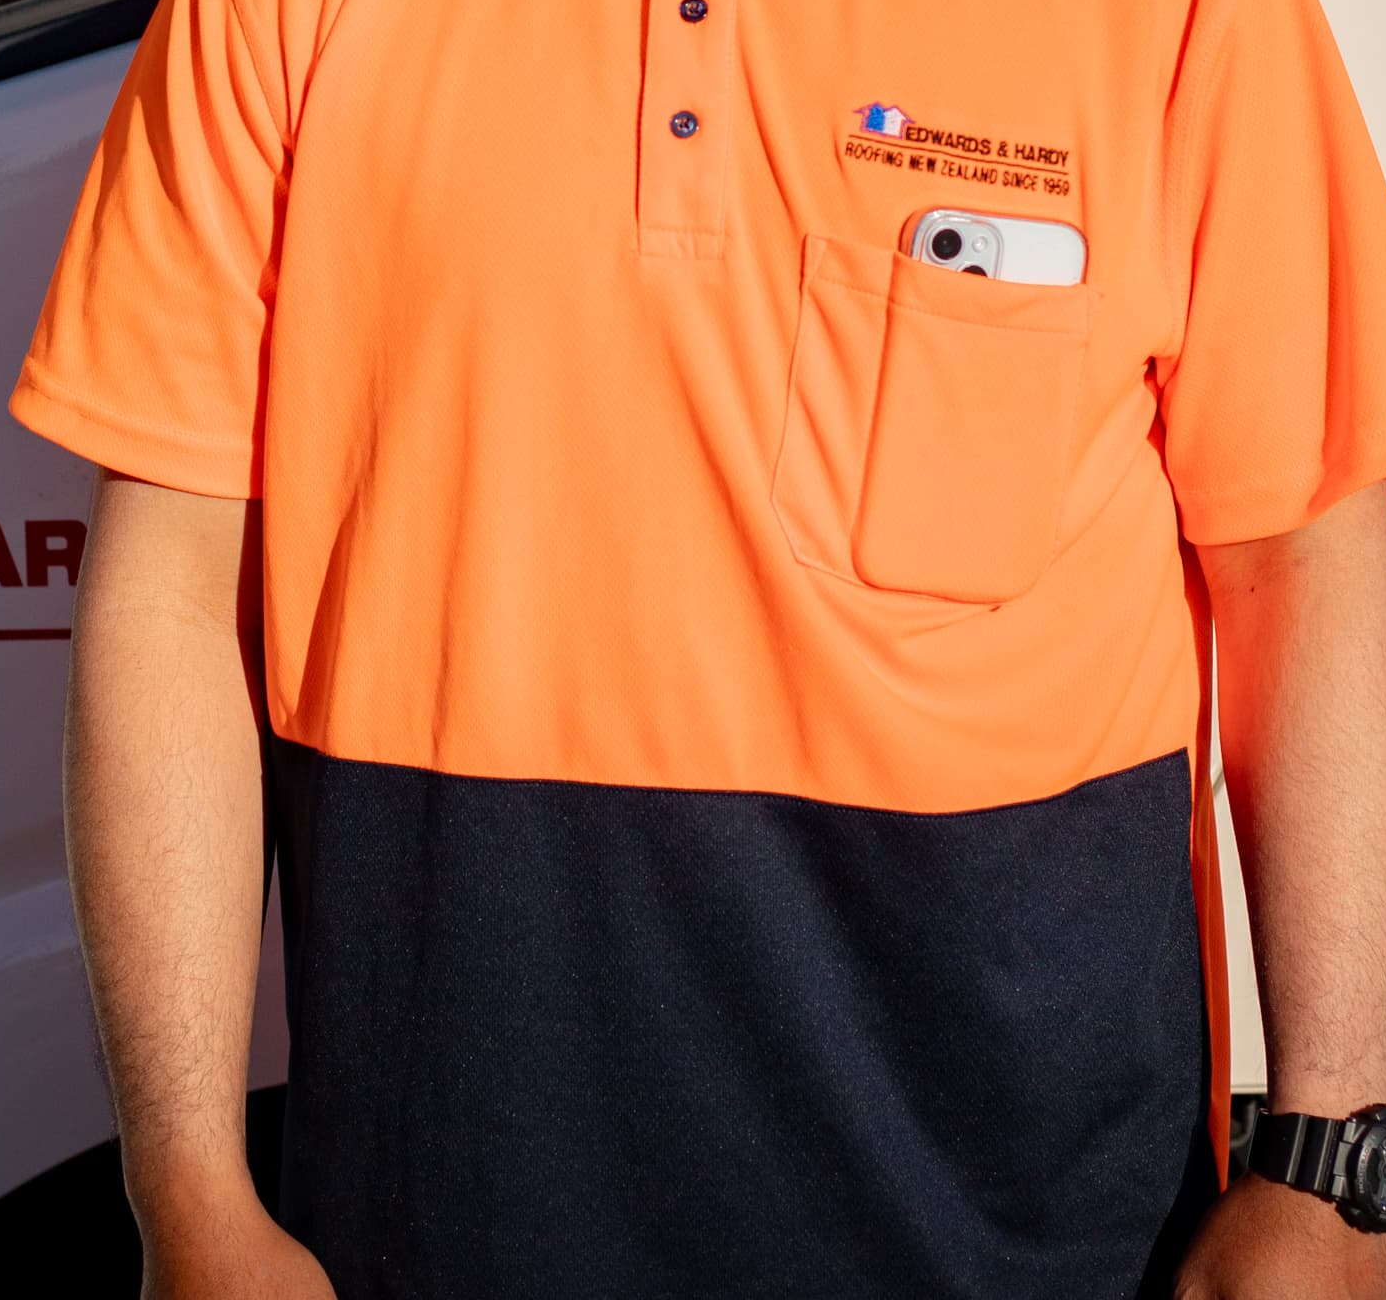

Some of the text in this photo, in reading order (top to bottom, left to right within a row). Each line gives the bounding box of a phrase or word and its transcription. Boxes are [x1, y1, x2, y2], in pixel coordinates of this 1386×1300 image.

[845, 142, 903, 168] ROOFING
[909, 155, 938, 174] NEW
[940, 159, 998, 185] ZEALAND
[1002, 171, 1038, 192] SINCE
[905, 126, 1069, 167] EDWARDS & HARDY
